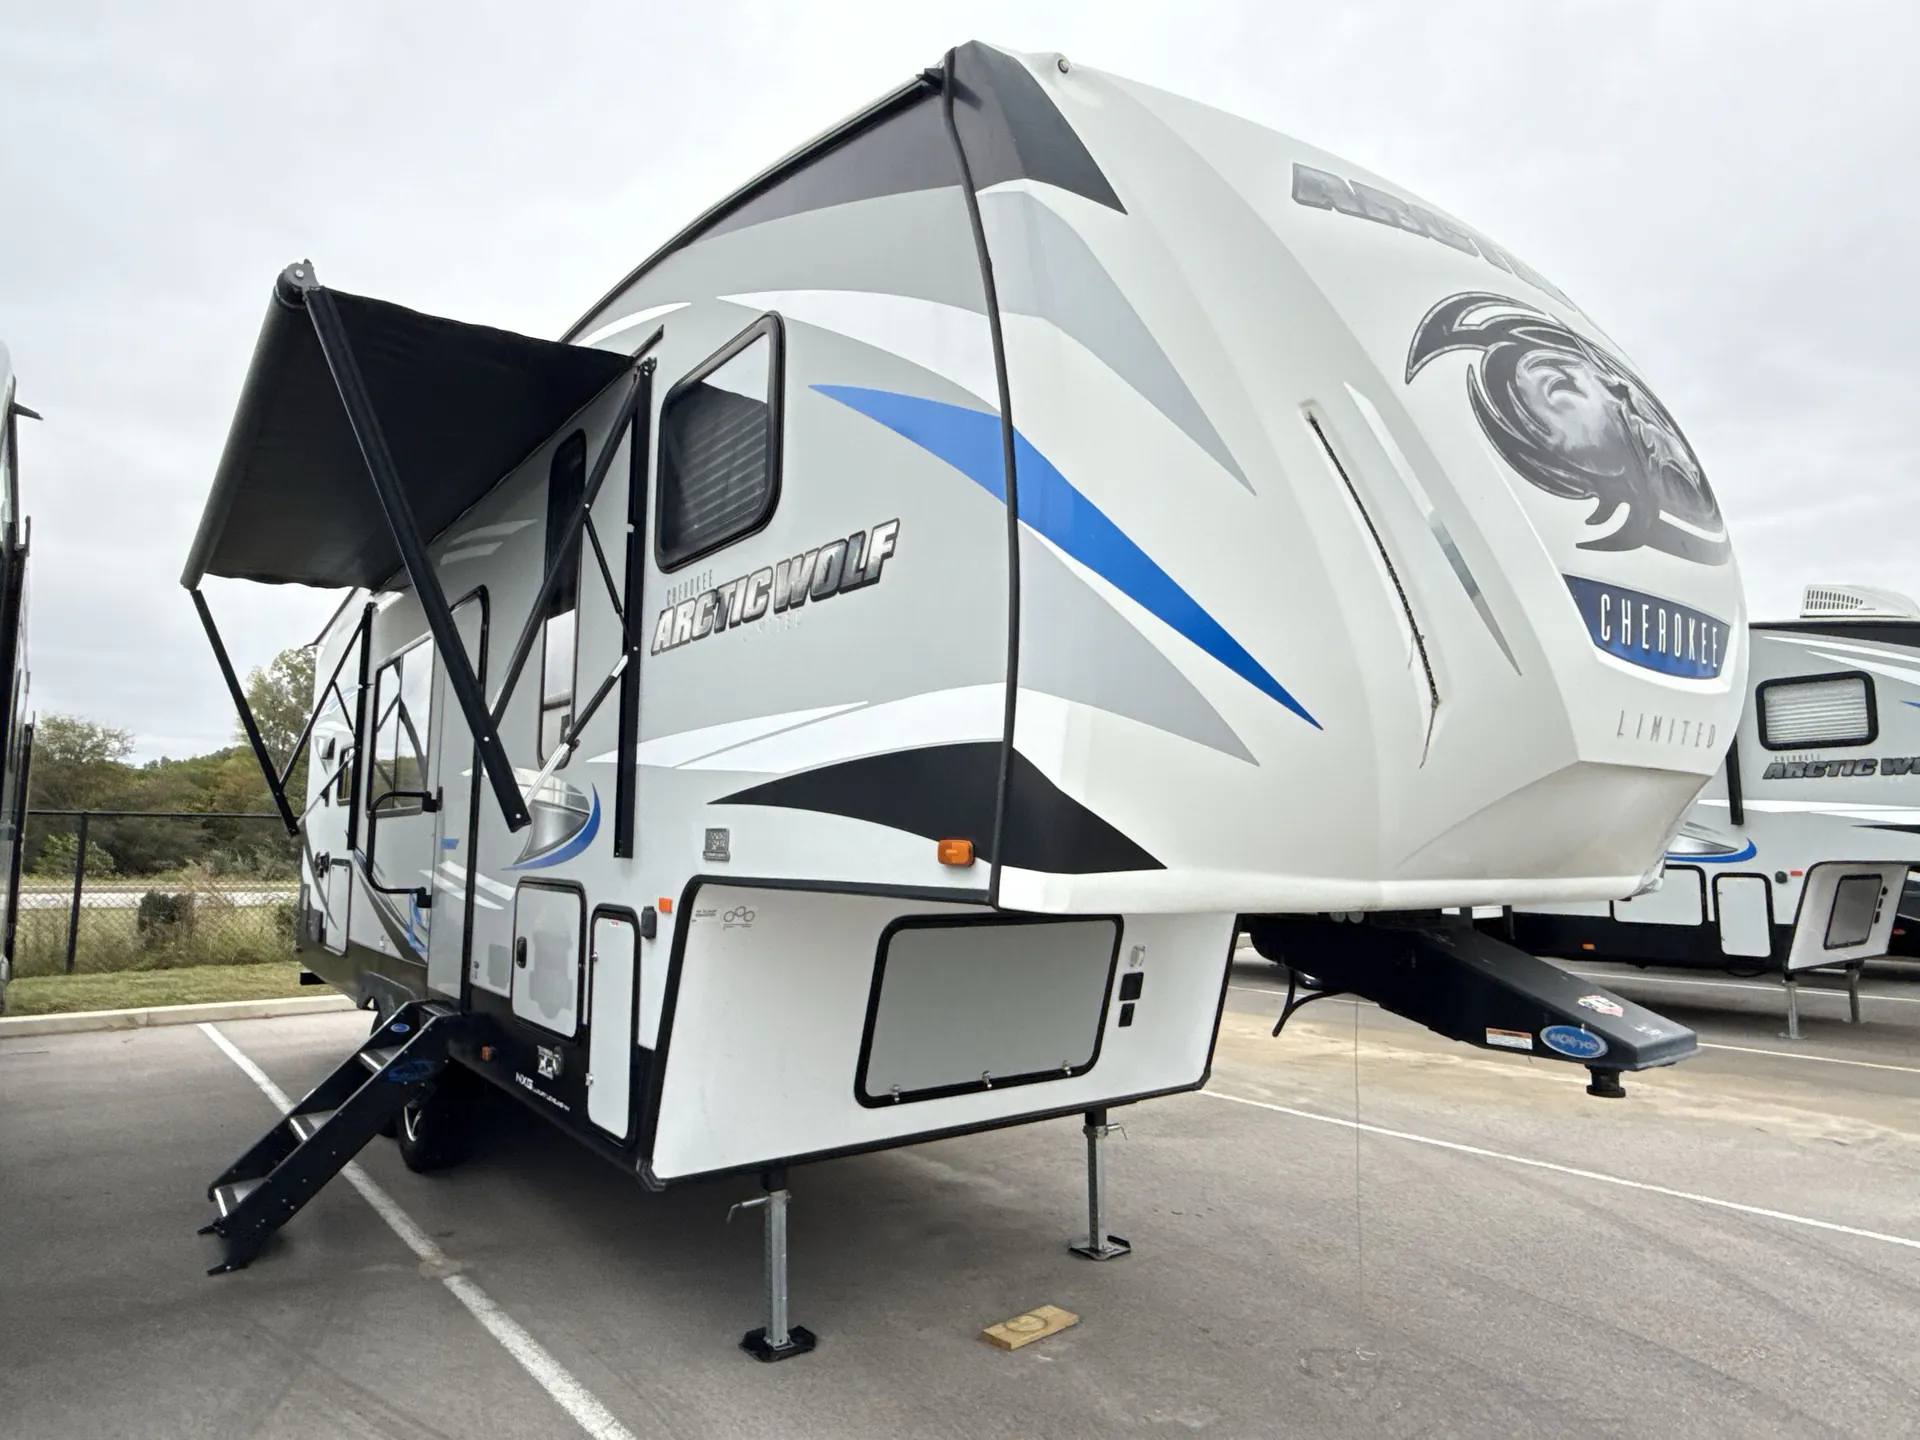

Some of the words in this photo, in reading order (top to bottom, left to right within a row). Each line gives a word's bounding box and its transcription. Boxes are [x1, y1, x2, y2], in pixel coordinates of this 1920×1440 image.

[651, 565, 774, 656] ARCTIC
[773, 517, 900, 613] WOLF
[666, 569, 713, 607] CHEROKEE
[1600, 593, 1718, 668] CHEROKEE
[1616, 709, 1716, 749] LIMITED
[1762, 758, 1878, 780] ARCTIC
